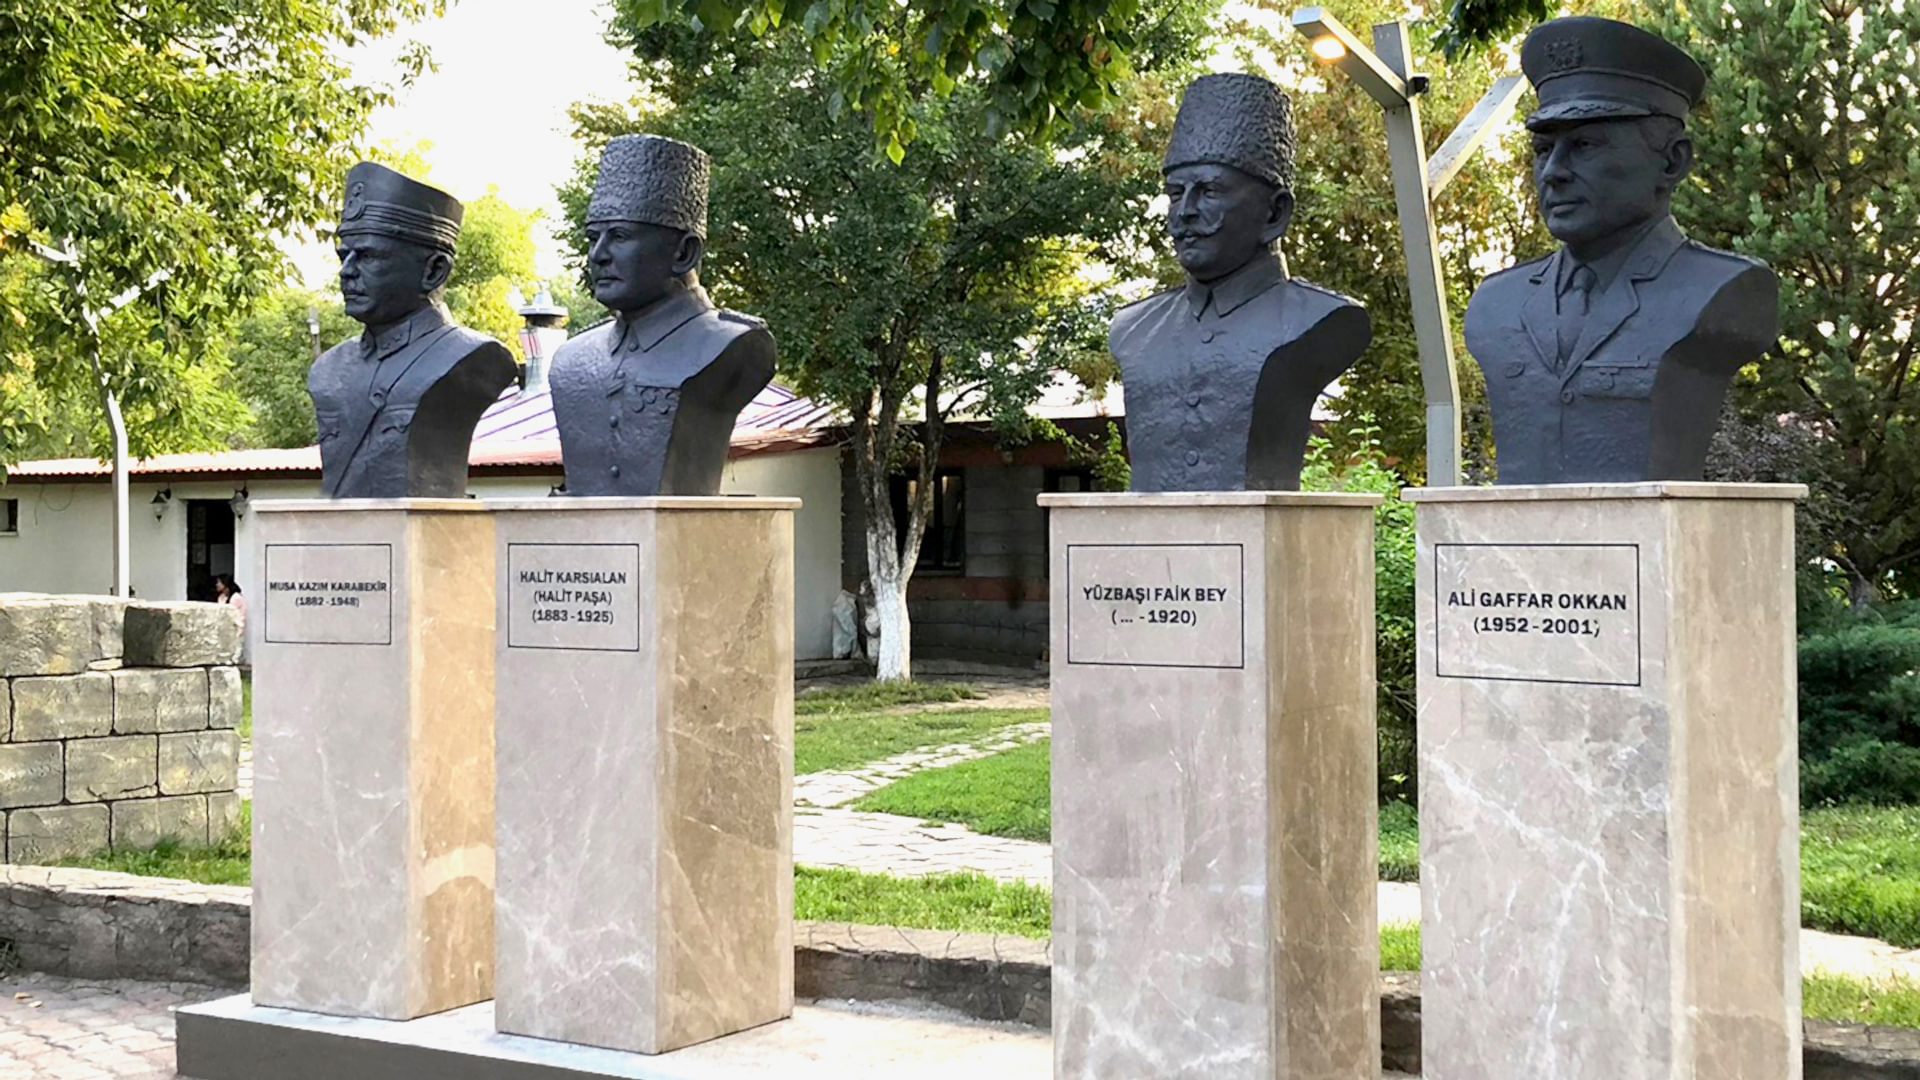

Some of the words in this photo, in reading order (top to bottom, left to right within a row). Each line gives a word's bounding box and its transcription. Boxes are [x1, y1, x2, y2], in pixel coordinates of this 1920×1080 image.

[520, 569, 554, 583] HALİT
[556, 571, 627, 584] KARSIALAN
[269, 582, 296, 591] MUSA
[298, 582, 328, 591] KAZIM
[331, 580, 387, 592] KARABEKİR
[1083, 584, 1150, 605] YÜZBAŞI
[1154, 585, 1191, 602] FAİK
[1195, 588, 1227, 602] BEY
[534, 588, 572, 604] (HALİT
[575, 591, 613, 606] PAŞA)
[1448, 588, 1475, 607] ALİ
[1480, 592, 1553, 609] GAFFAR
[1558, 593, 1627, 611] OKKAN
[1147, 609, 1197, 627] 1920)
